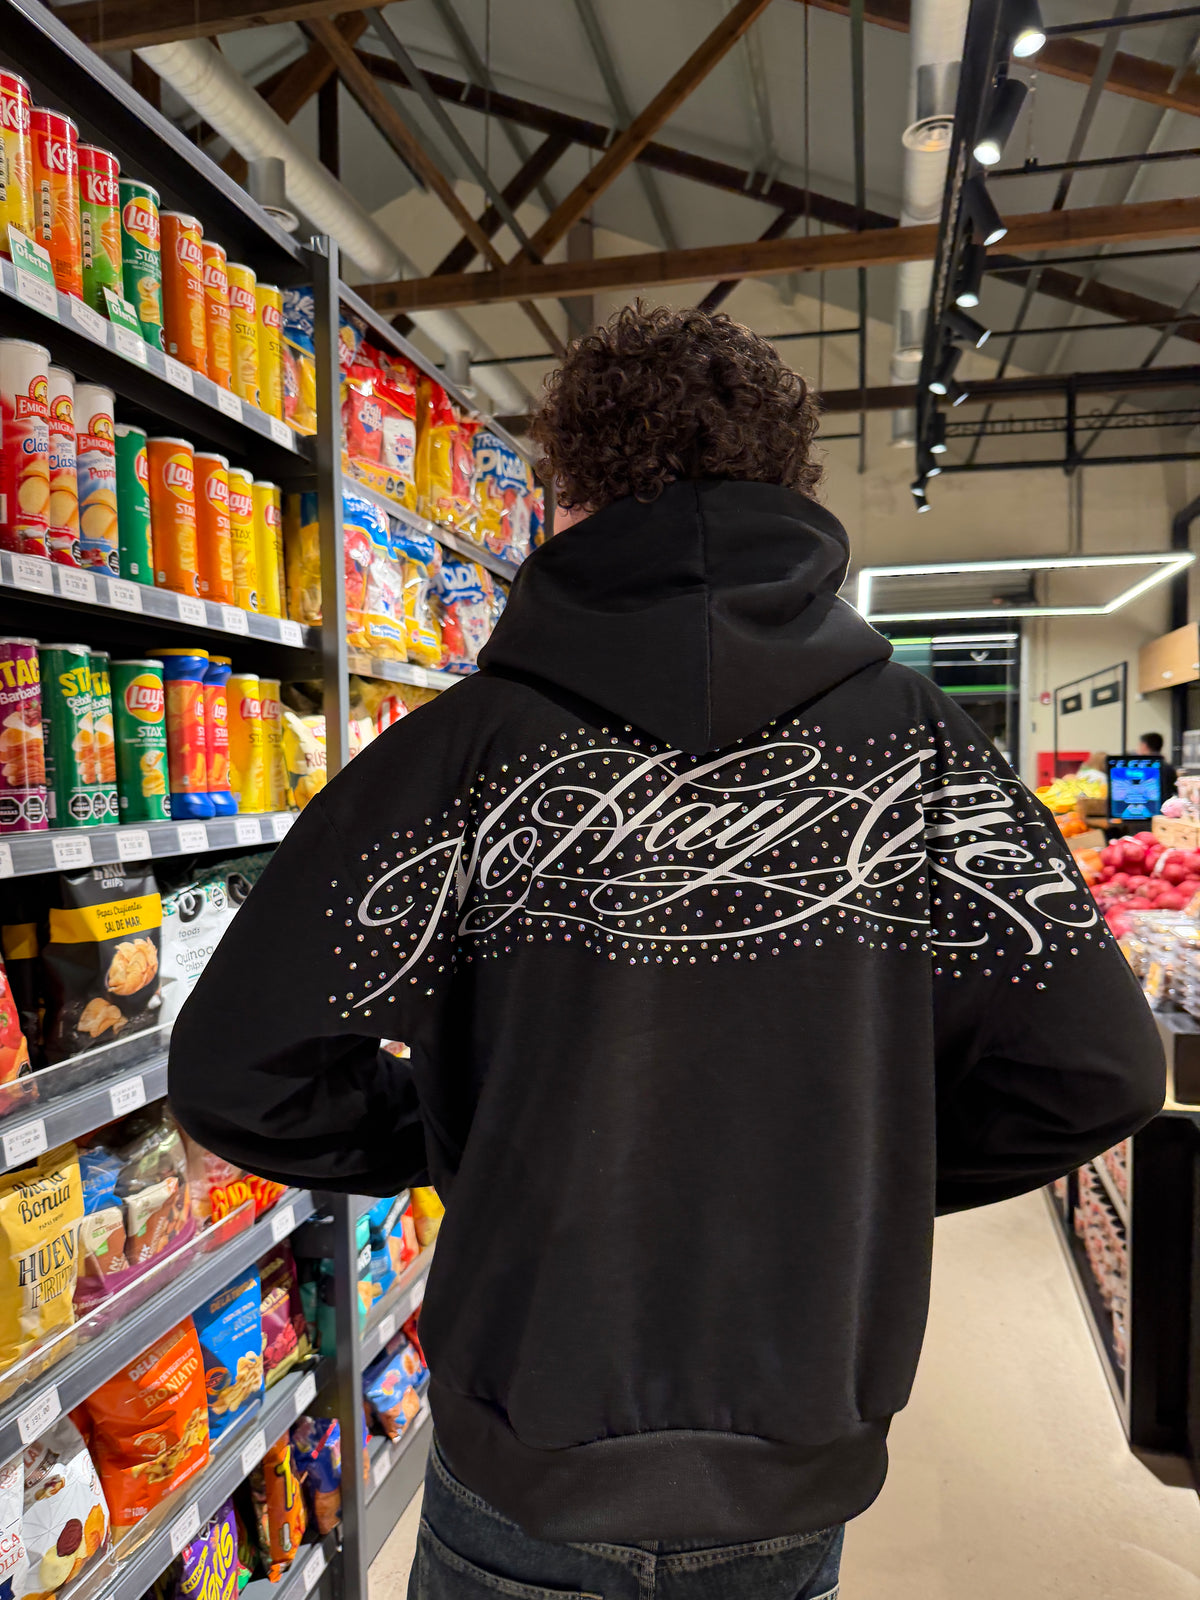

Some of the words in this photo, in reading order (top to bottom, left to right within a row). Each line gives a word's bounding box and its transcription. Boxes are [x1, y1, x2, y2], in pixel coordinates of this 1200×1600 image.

[15, 243, 49, 273] Oferta
[137, 726, 164, 738] STAX
[101, 878, 124, 889] CHIPS
[344, 749, 580, 1008] No
[530, 743, 823, 916] Hay
[105, 921, 116, 933] SAL
[115, 918, 125, 931] DE
[124, 915, 142, 929] MAR
[18, 1184, 70, 1225] Bonita
[144, 1357, 199, 1409] BONIATO
